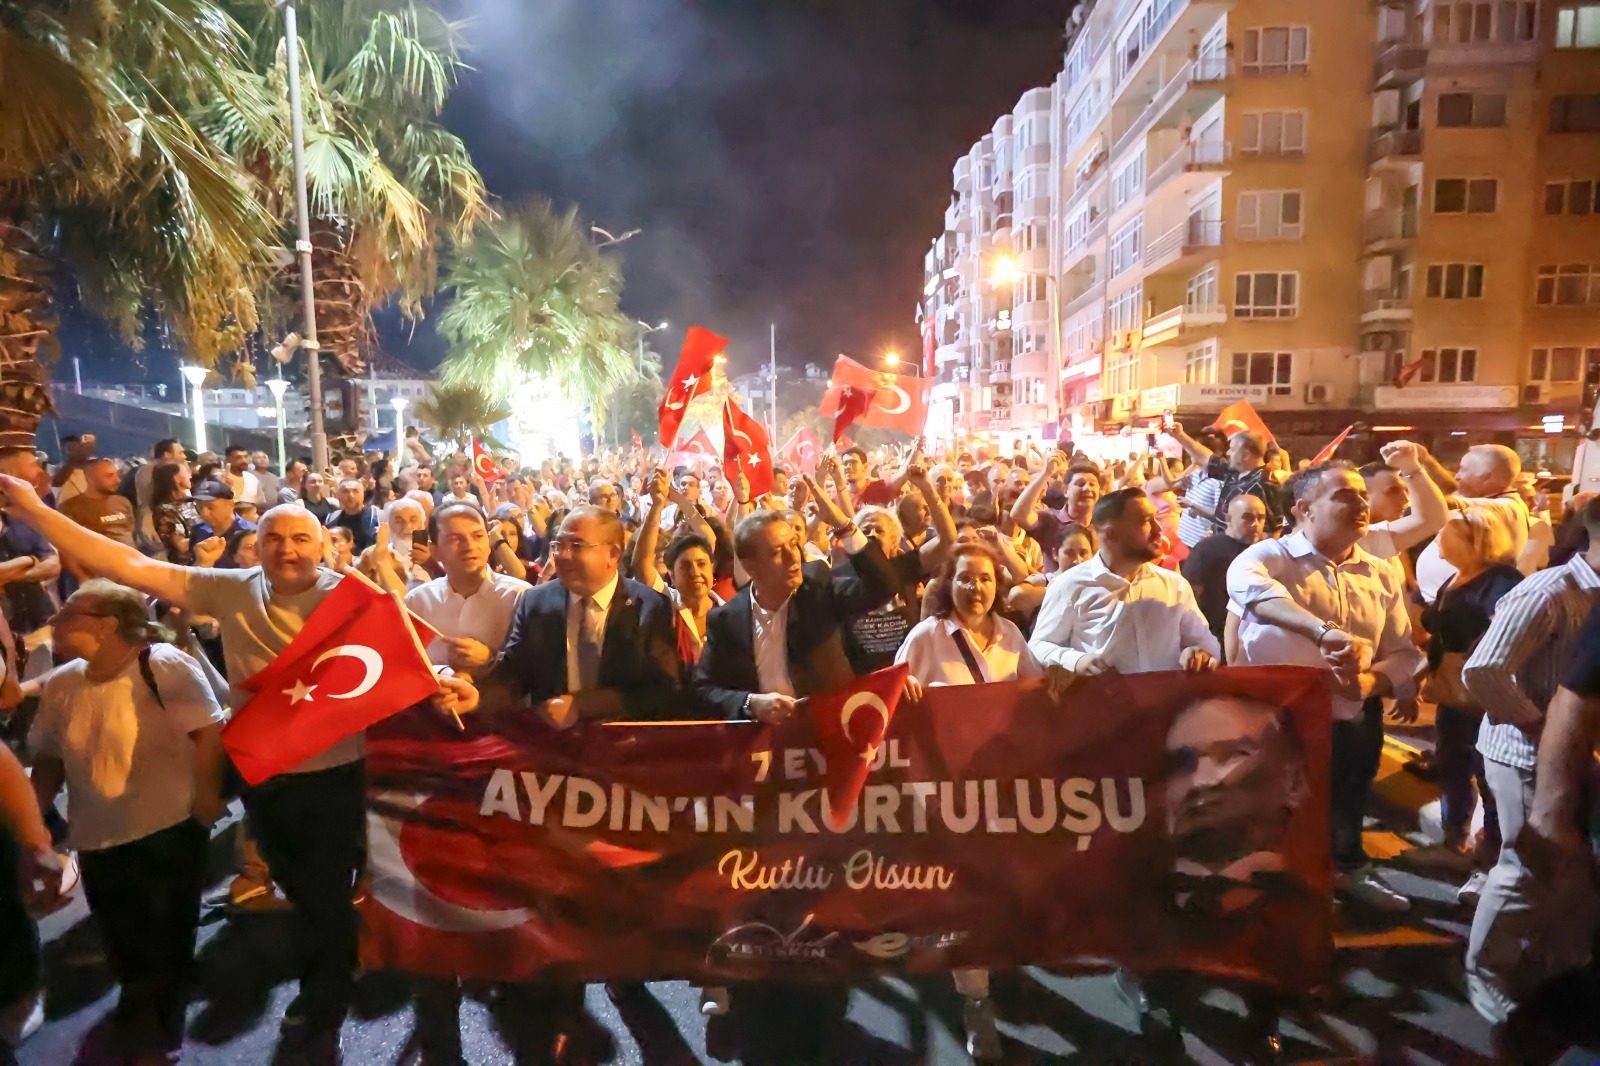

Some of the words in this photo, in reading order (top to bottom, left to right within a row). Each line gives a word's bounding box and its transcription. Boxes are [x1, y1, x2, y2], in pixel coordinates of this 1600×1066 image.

[751, 750, 772, 782] 7
[784, 739, 911, 780] EYL
[778, 776, 1146, 851] KURTULUŞU
[718, 849, 833, 890] Kutlu
[843, 849, 954, 890] Olsun
